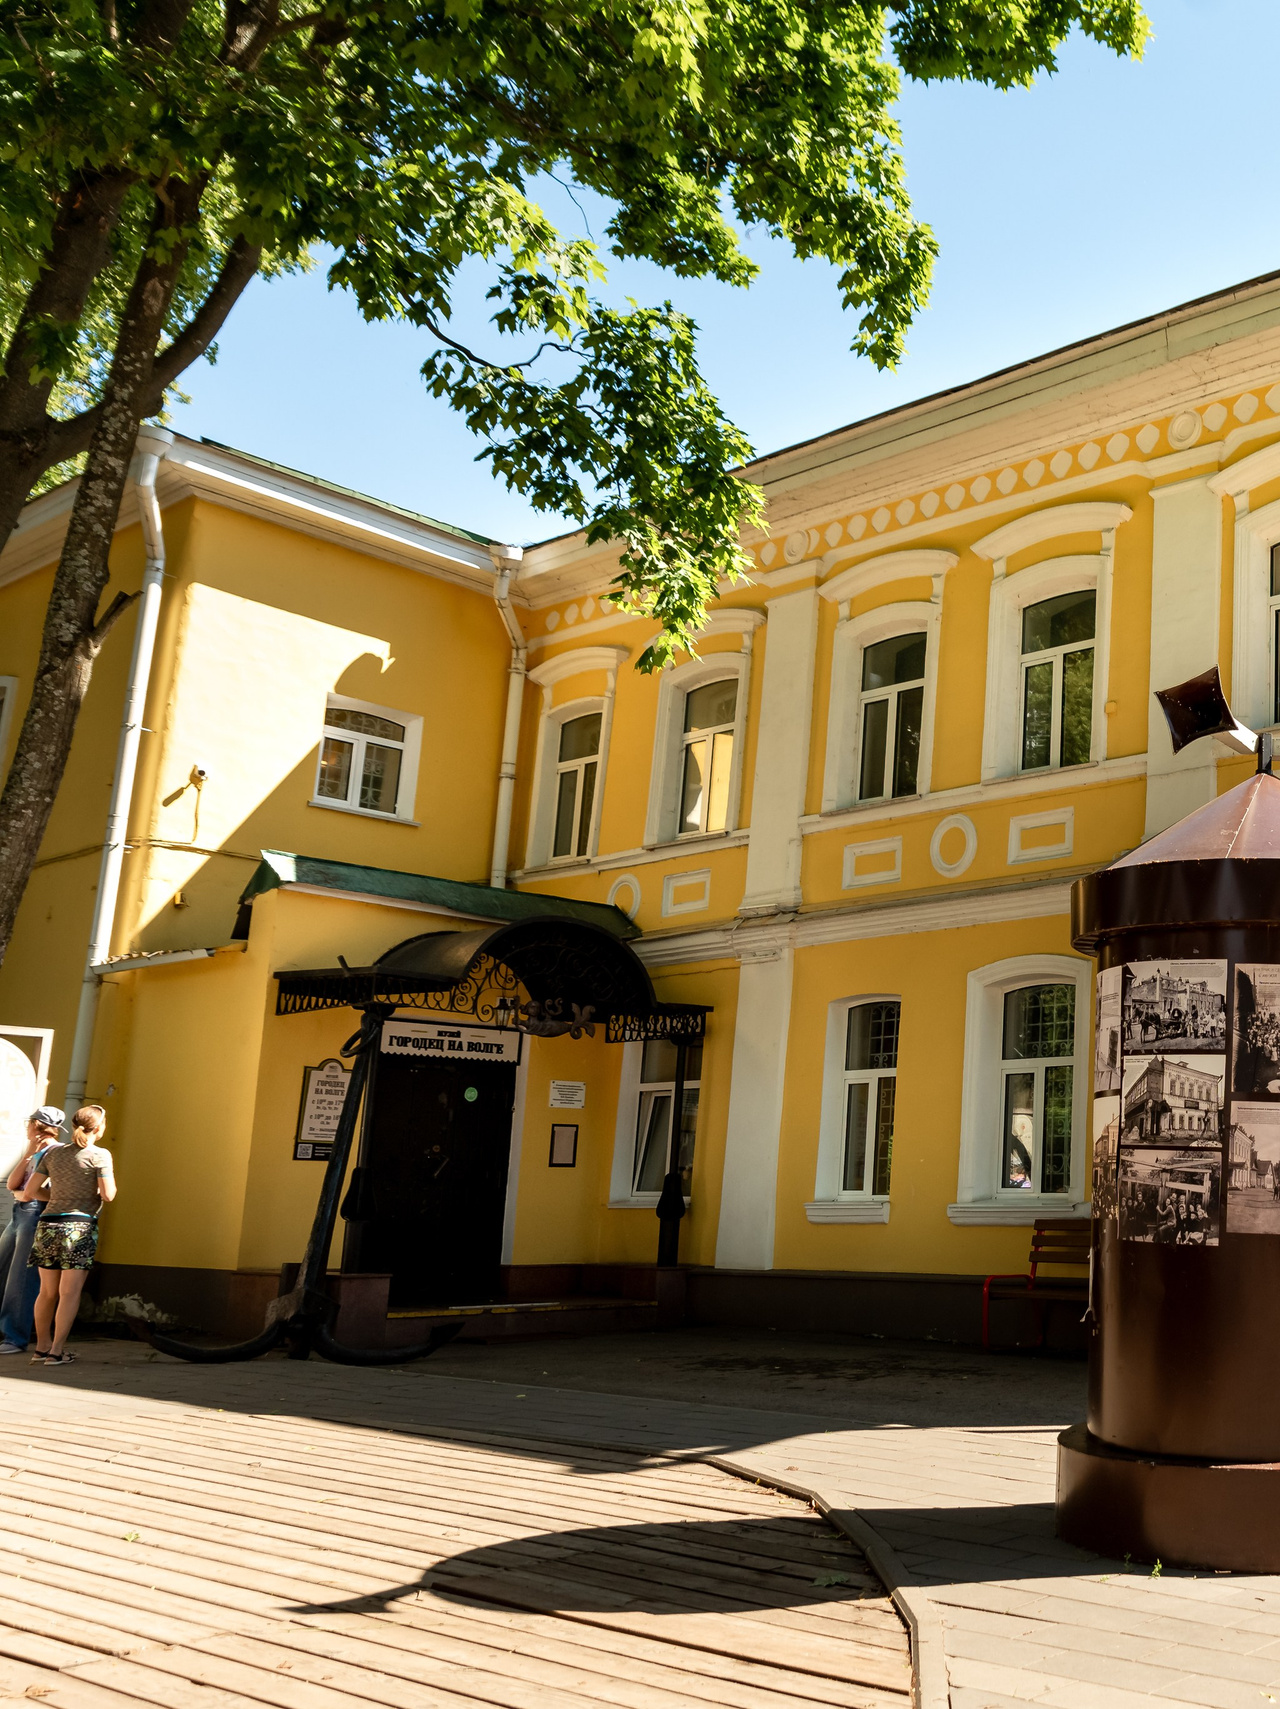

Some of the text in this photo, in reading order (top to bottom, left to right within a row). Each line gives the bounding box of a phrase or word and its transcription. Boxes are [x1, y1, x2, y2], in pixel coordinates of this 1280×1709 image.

[388, 1035, 504, 1054] ГОРОДЕЦ НА ВОЛГЕ
[316, 1080, 345, 1088] ГОРОДЕЦ
